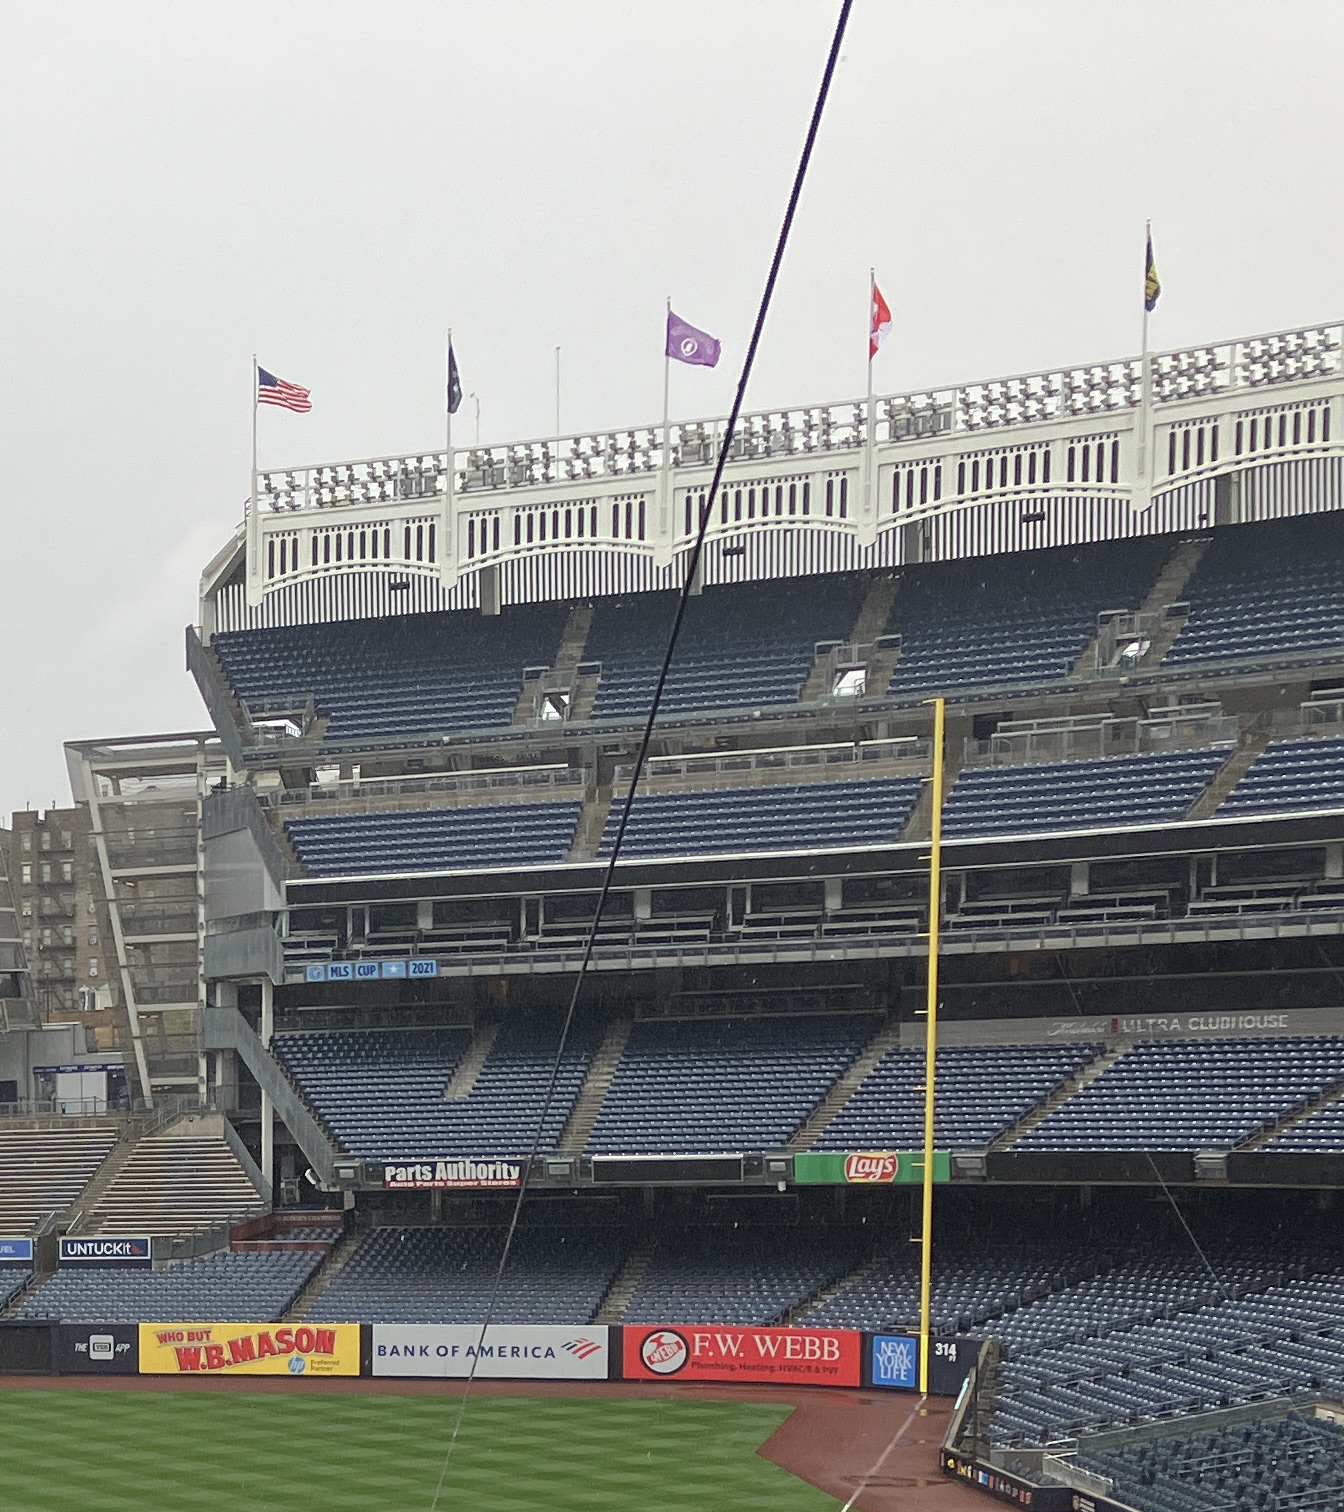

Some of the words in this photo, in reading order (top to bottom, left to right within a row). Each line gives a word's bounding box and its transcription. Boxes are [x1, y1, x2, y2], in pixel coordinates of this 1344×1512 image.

[330, 965, 349, 977] MLS
[358, 964, 376, 976] CUP
[412, 962, 434, 974] 2021
[1123, 1017, 1181, 1033] ULTRA
[1188, 1015, 1289, 1031] CLUBHOUSE
[385, 1164, 432, 1181] Parts
[435, 1160, 520, 1181] Authority
[67, 1243, 131, 1256] UNTUCKit
[155, 1331, 185, 1344] WHO
[187, 1330, 212, 1342] BUT
[377, 1345, 430, 1357] BANK
[436, 1345, 460, 1357] OF
[465, 1345, 556, 1359] AMERICA
[692, 1333, 745, 1358] F.W.
[752, 1334, 841, 1360] WEBB
[880, 1341, 909, 1355] NEW
[935, 1342, 957, 1357] 314
[290, 1358, 305, 1373] hp
[876, 1353, 912, 1369] YORK
[881, 1366, 907, 1381] LIFE
